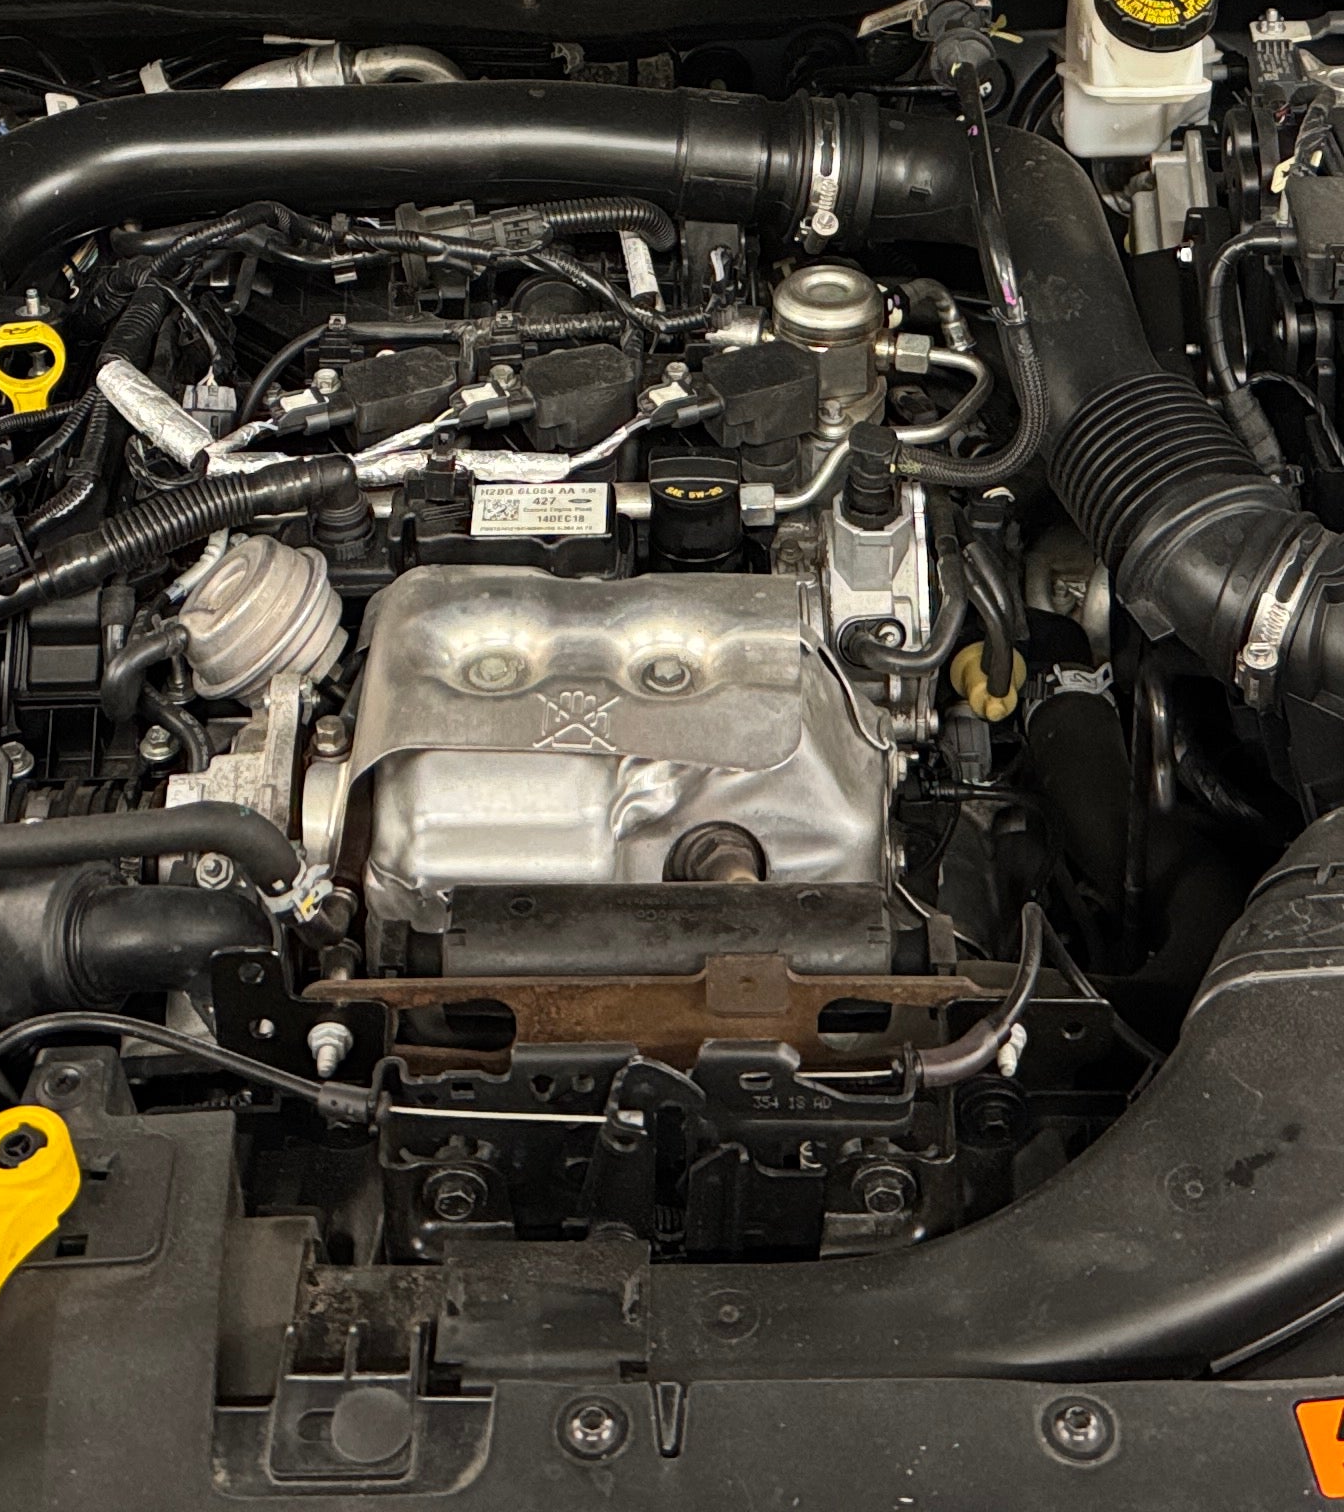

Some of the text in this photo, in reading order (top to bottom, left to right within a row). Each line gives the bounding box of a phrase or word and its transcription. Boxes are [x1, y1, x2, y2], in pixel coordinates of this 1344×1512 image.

[558, 487, 576, 495] AA
[665, 486, 685, 498] SAE
[532, 497, 557, 505] 427
[537, 515, 585, 523] 14DEC18
